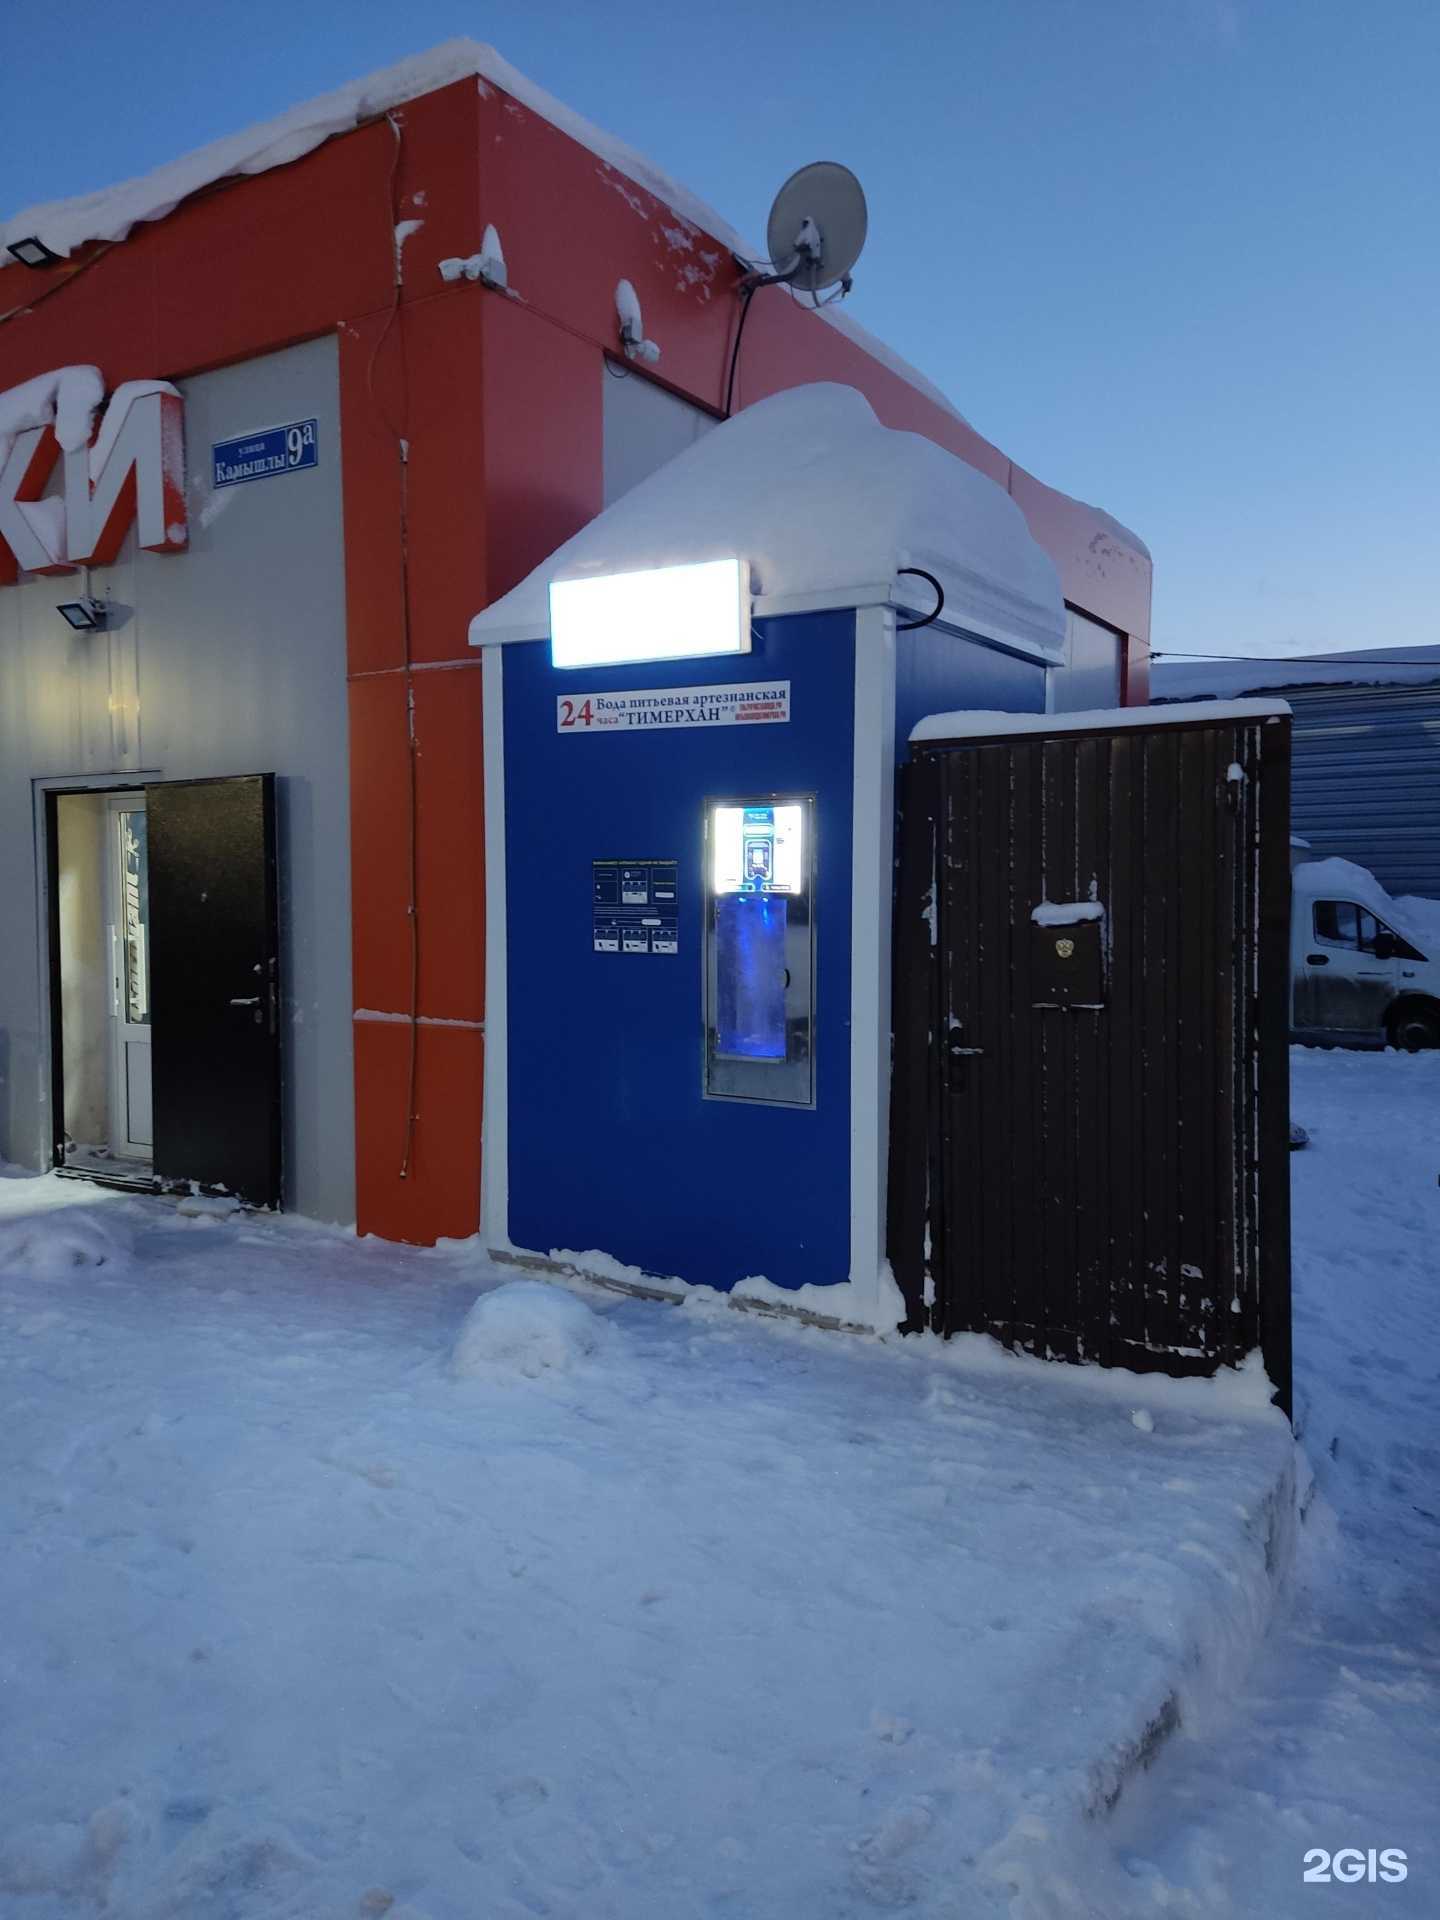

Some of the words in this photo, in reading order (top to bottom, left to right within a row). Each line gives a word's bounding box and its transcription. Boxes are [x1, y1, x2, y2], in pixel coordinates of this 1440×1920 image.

[216, 454, 285, 481] Камышлы
[561, 699, 594, 726] 24
[629, 695, 689, 709] питьевая
[692, 689, 786, 707] артезианская
